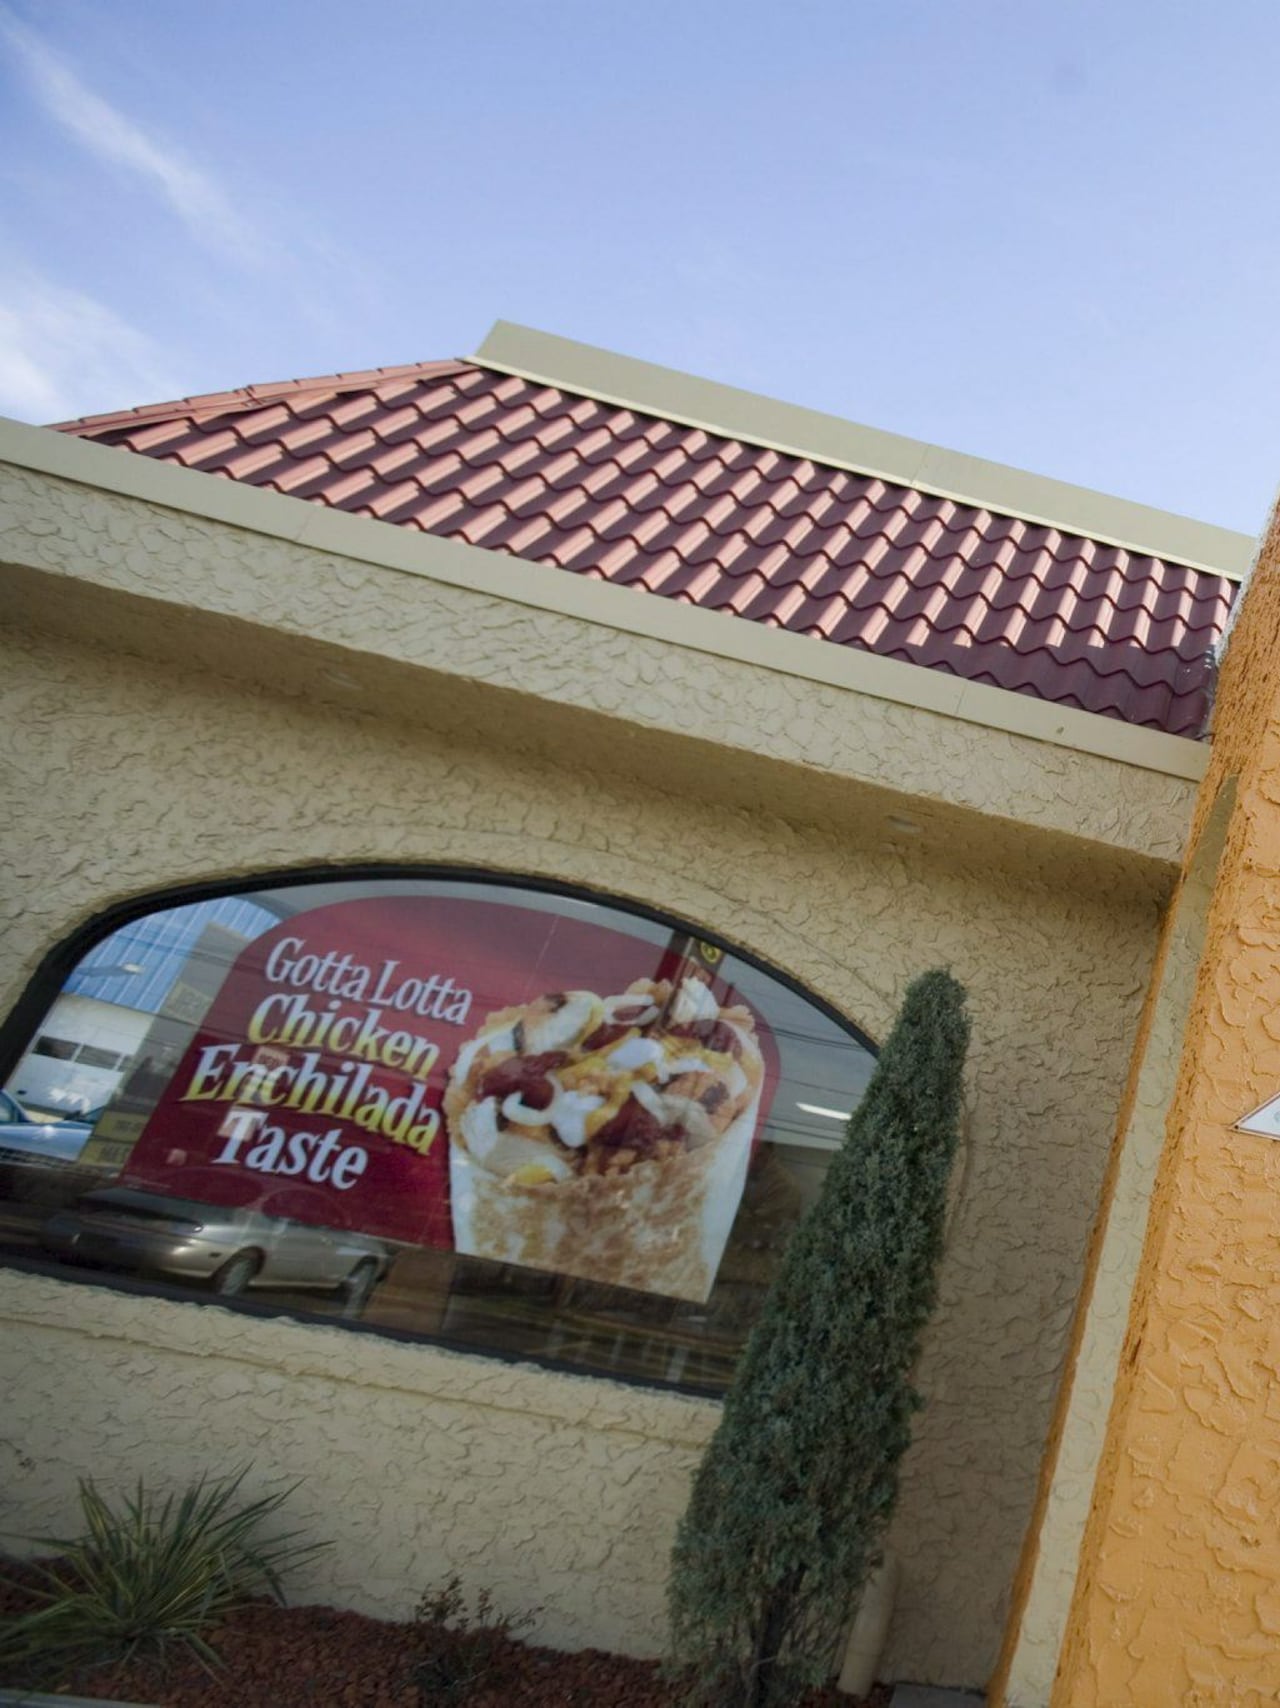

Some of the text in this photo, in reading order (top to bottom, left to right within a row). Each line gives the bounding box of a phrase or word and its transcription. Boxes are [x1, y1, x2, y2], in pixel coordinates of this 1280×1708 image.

[264, 936, 473, 1026] Gotta Lotta
[246, 992, 441, 1083] Chicken
[178, 1043, 442, 1157] Enchilada
[211, 1108, 369, 1190] Taste
